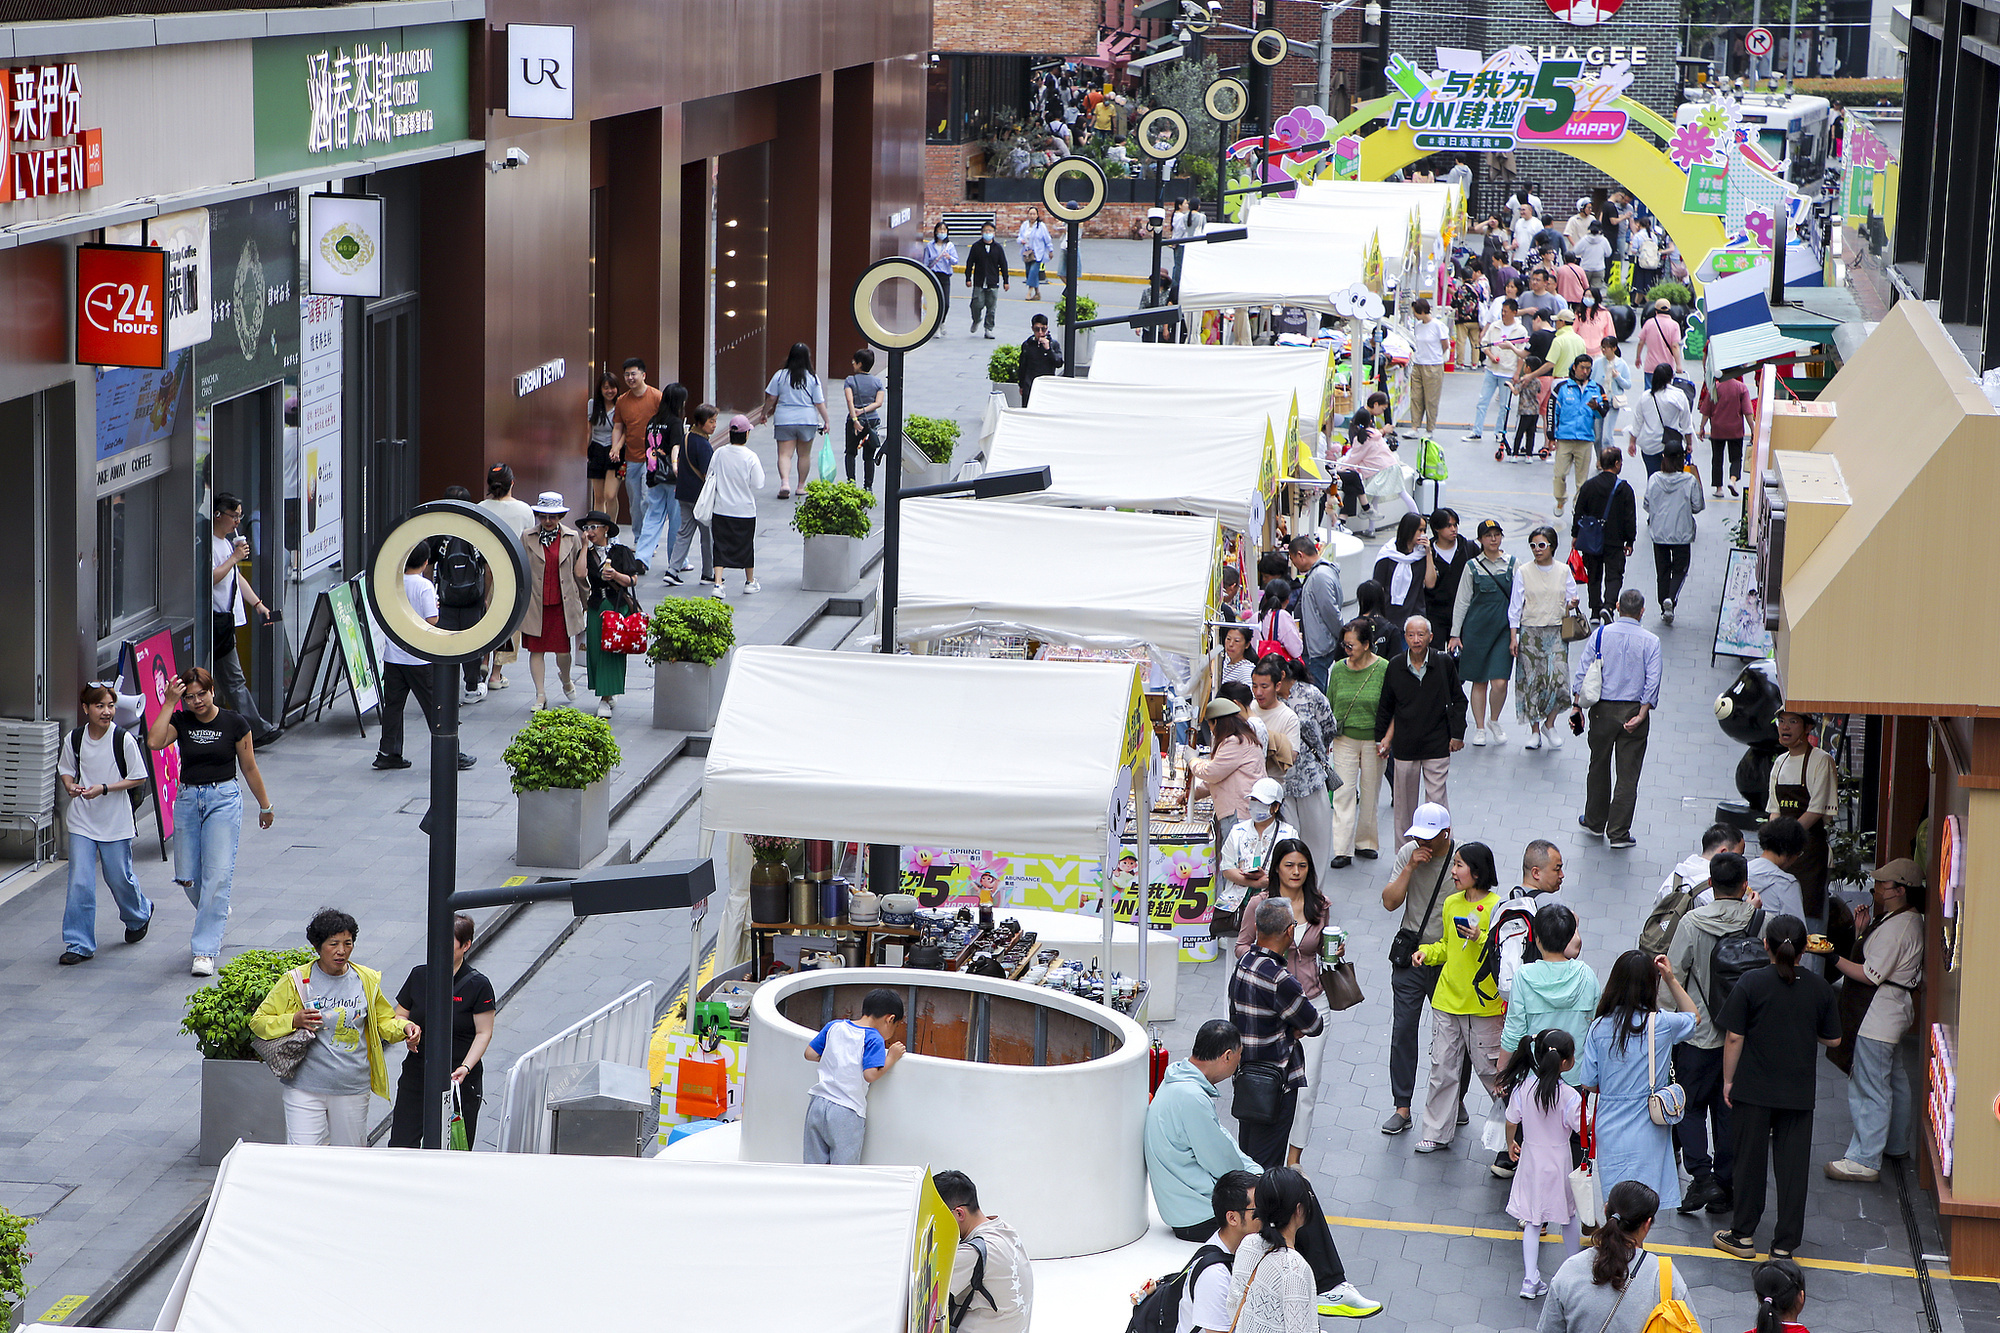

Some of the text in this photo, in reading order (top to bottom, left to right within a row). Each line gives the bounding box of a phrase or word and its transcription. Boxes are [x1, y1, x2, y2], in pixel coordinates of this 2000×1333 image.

[393, 48, 433, 77] HANCHUN
[520, 57, 567, 89] UR
[14, 63, 82, 142] 来伊份
[306, 41, 395, 153] 涵春茶肆
[393, 79, 419, 106] CHASI
[1440, 70, 1536, 99] 与我为
[1525, 61, 1584, 132] 5
[1390, 101, 1456, 128] FUN
[1565, 123, 1621, 135] HAPPY
[88, 143, 100, 159] LAB
[15, 145, 84, 200] LYFEN
[118, 283, 154, 322] 24
[113, 319, 159, 335] hours
[131, 453, 153, 473] COFFEE
[919, 864, 951, 907] 5
[1177, 876, 1213, 920] 5
